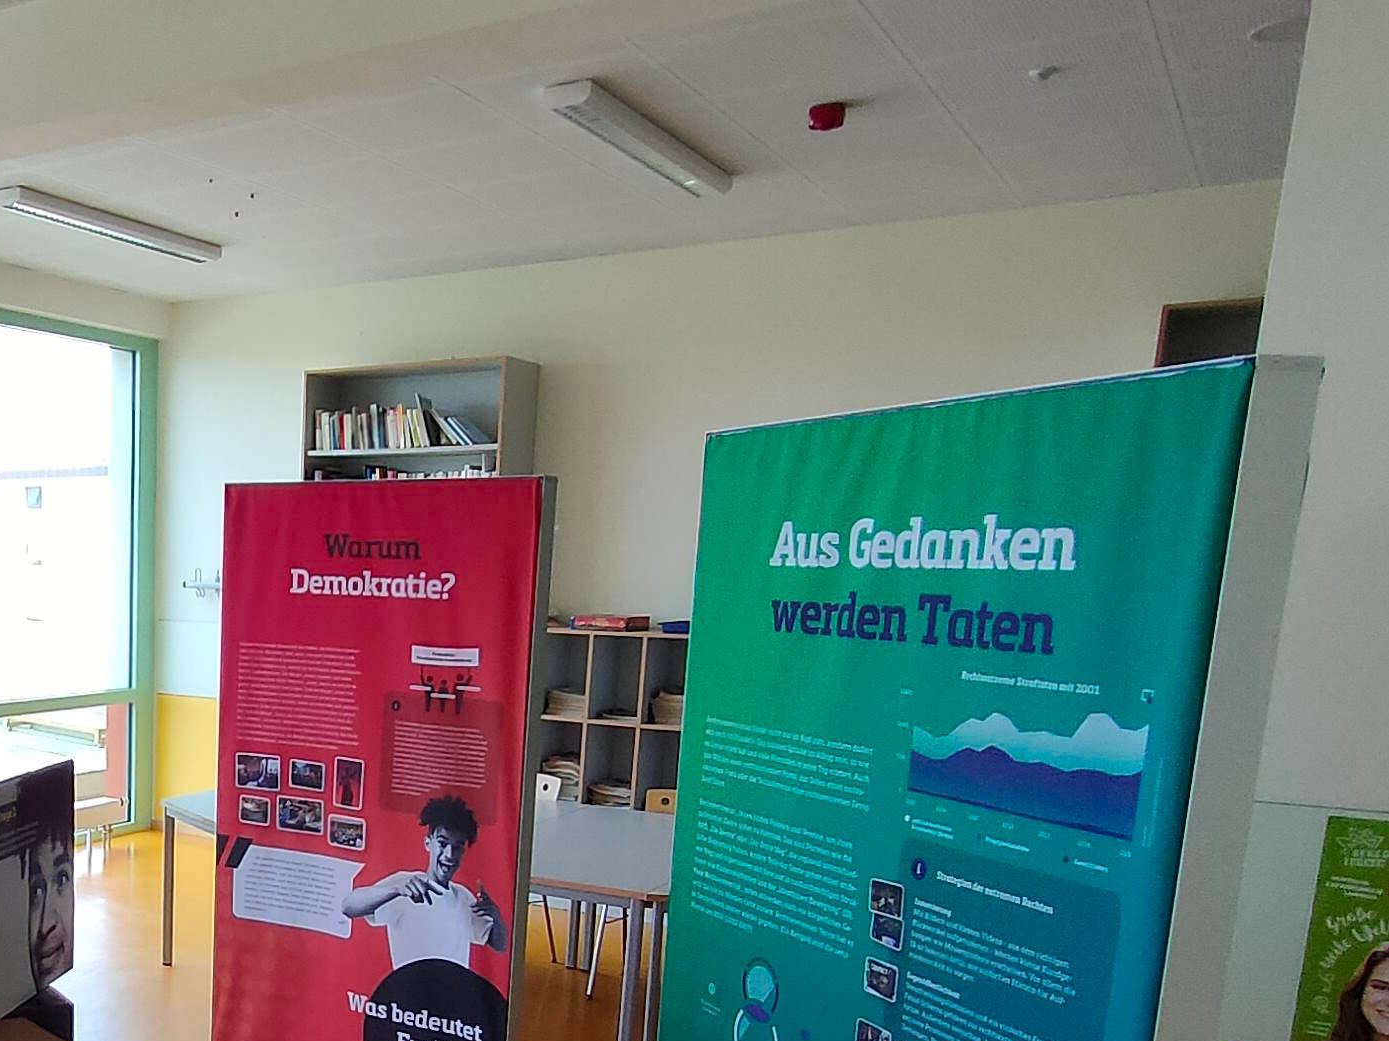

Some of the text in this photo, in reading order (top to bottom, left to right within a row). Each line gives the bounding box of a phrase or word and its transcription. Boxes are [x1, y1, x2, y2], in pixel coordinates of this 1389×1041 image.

[324, 533, 421, 560] Warum
[769, 512, 1077, 572] Aus Gedanken
[289, 567, 456, 600] Demokratie?
[771, 591, 1054, 655] werden Taten
[1075, 683, 1100, 696] 2001
[347, 991, 388, 1021] Was
